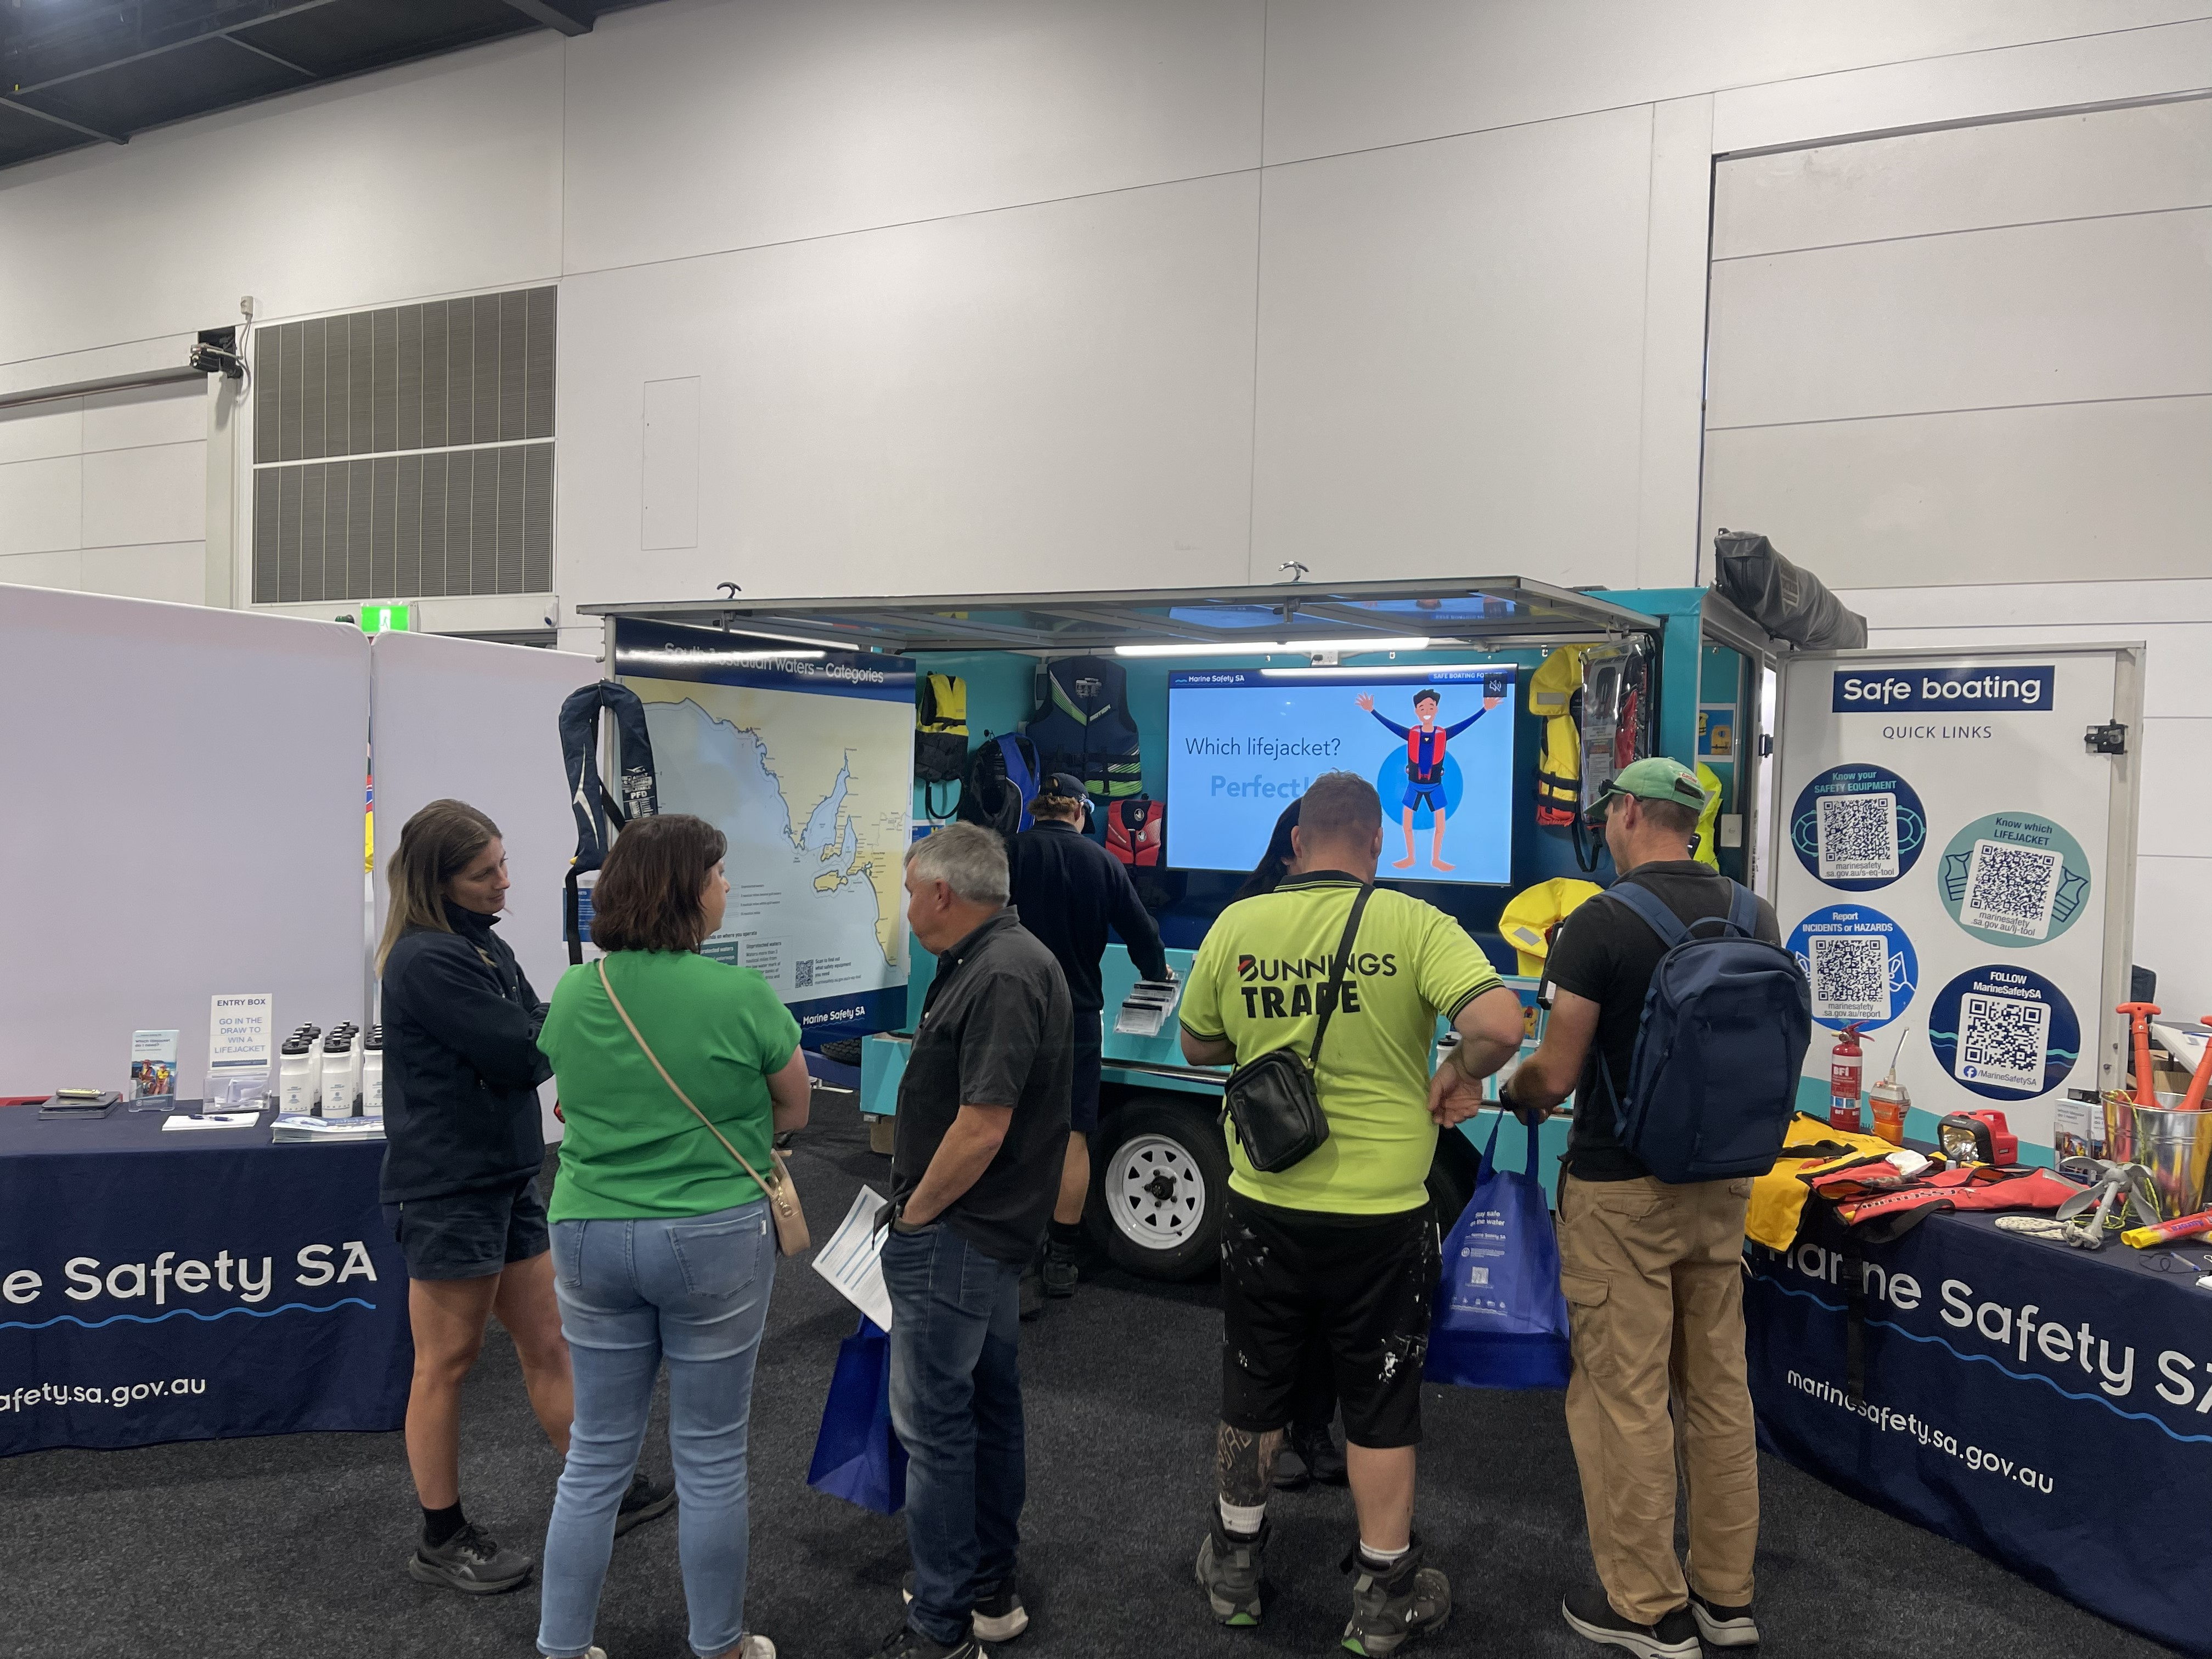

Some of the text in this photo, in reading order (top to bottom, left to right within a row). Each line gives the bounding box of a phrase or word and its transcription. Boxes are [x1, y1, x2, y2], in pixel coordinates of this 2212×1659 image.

[775, 658, 814, 675] Waters
[826, 663, 884, 685] Categories
[1843, 675, 2041, 705] Safe boating
[1883, 726, 1992, 740] QUICK LINKS
[1185, 737, 1341, 761] Which lifejacket?
[1858, 771, 1877, 781] your
[1211, 774, 1309, 798] Perfect!
[1814, 781, 1897, 793] SAFETY EQUIPMENT
[630, 791, 647, 799] PFD
[1995, 817, 2053, 834] Know which
[1994, 829, 2050, 846] LIFEJACKET
[1832, 912, 1859, 921] Report
[1979, 912, 2030, 929] marinesafety
[1803, 924, 1843, 932] INCIDENTS
[1854, 923, 1893, 932] HAZARDS
[1990, 972, 2027, 984] FOLLOW
[1973, 981, 2042, 998] MarineSafetySA
[803, 1006, 865, 1025] Marine Safety SA
[1828, 1003, 1874, 1011] marinesafety
[215, 1045, 266, 1053] LIFEJACKET
[1978, 1070, 2037, 1086] /MarineSafetySA
[64, 1250, 272, 1305] Safety
[295, 1240, 377, 1287] SA
[1768, 1242, 1922, 1310] arne
[1939, 1279, 2135, 1396] Safety
[0, 1378, 206, 1413] afety.sa.gov.au
